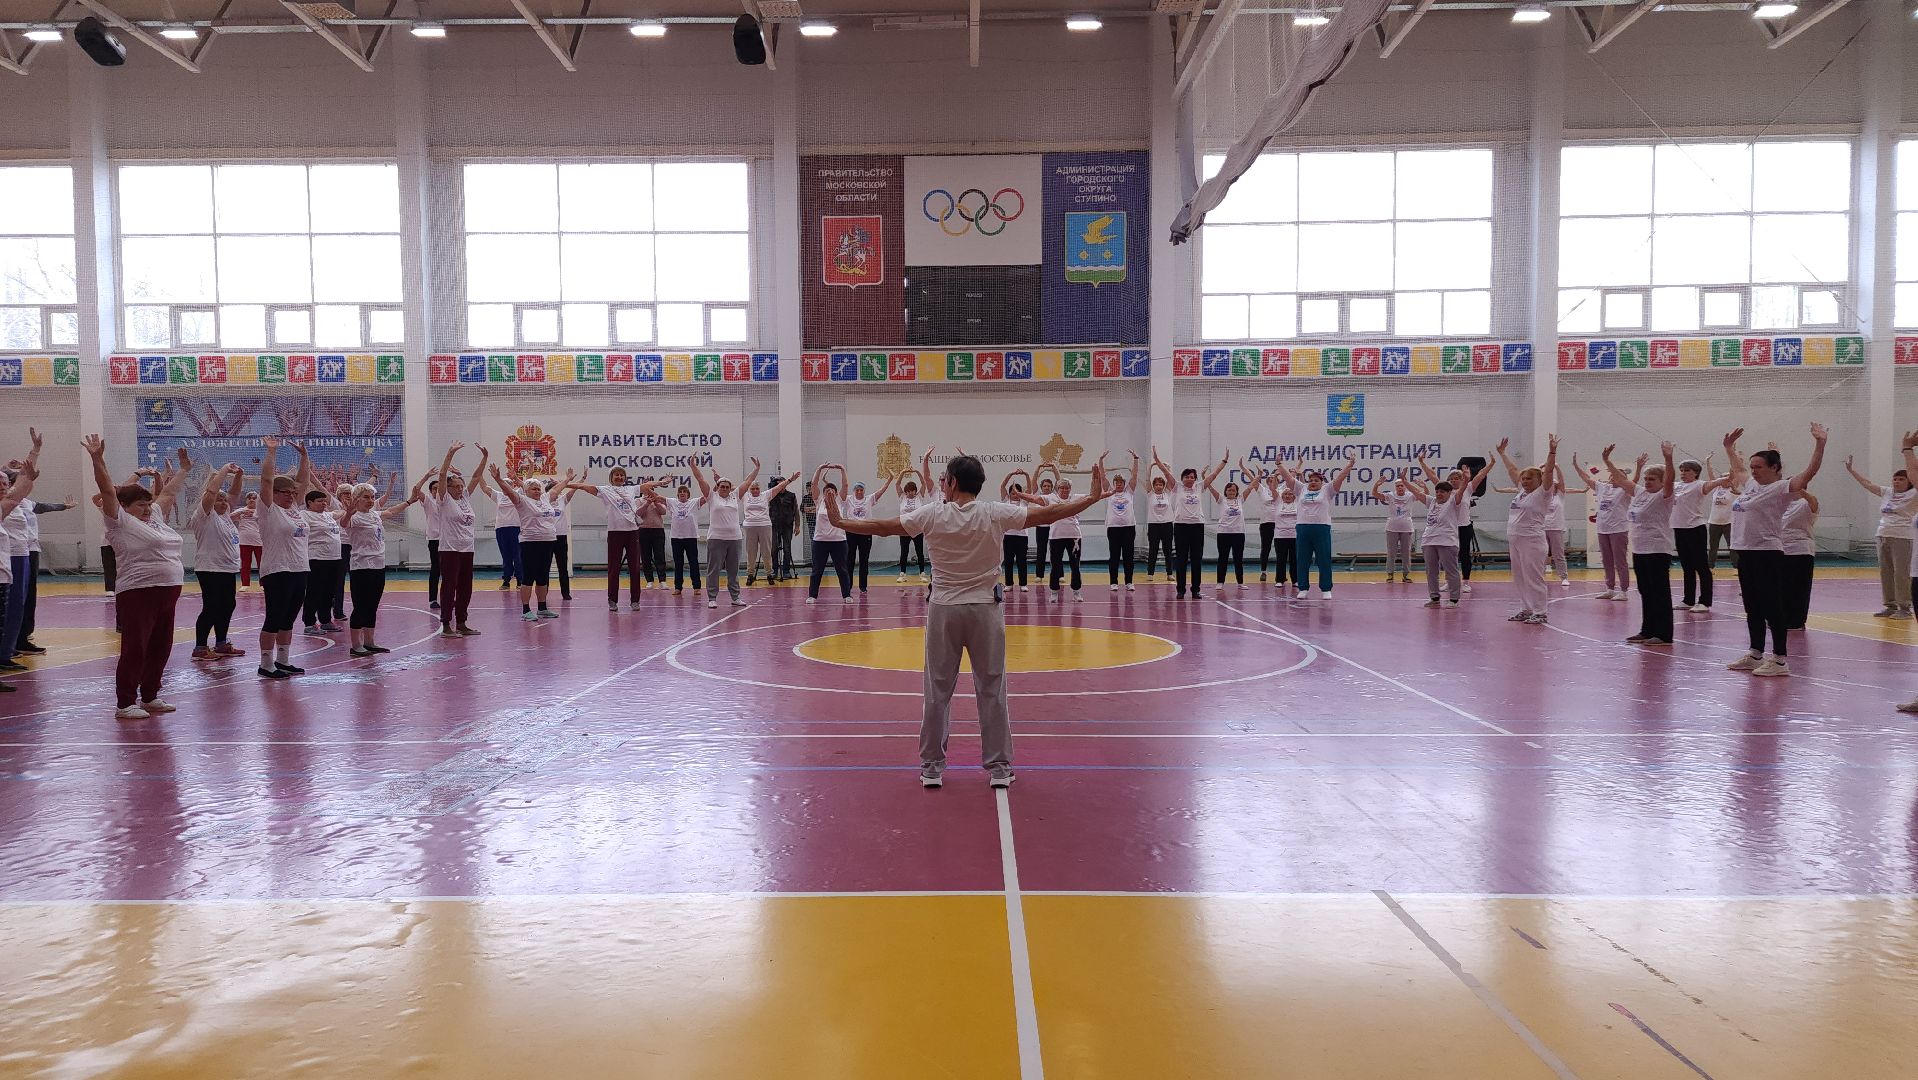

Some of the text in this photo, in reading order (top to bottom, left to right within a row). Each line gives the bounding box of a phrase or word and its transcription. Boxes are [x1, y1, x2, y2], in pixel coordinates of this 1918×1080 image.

[818, 168, 893, 177] ПРАВИТЕЛЬСТВО
[1056, 164, 1135, 175] АДМИНИСТРАЦИЯ
[1066, 175, 1125, 184] ГОРОДСКОГО
[826, 180, 887, 189] МОСКОВСКОЙ
[1078, 185, 1112, 193] ОКРУГА
[835, 193, 877, 202] ОБЛАСТИ
[1074, 194, 1117, 203] СТУПИНО
[578, 433, 722, 447] ПРАВИТЕЛЬСТВО
[1248, 442, 1441, 464] АДМИНИСТРАЦИЯ
[588, 451, 713, 468] МОСКОВСКОЙ
